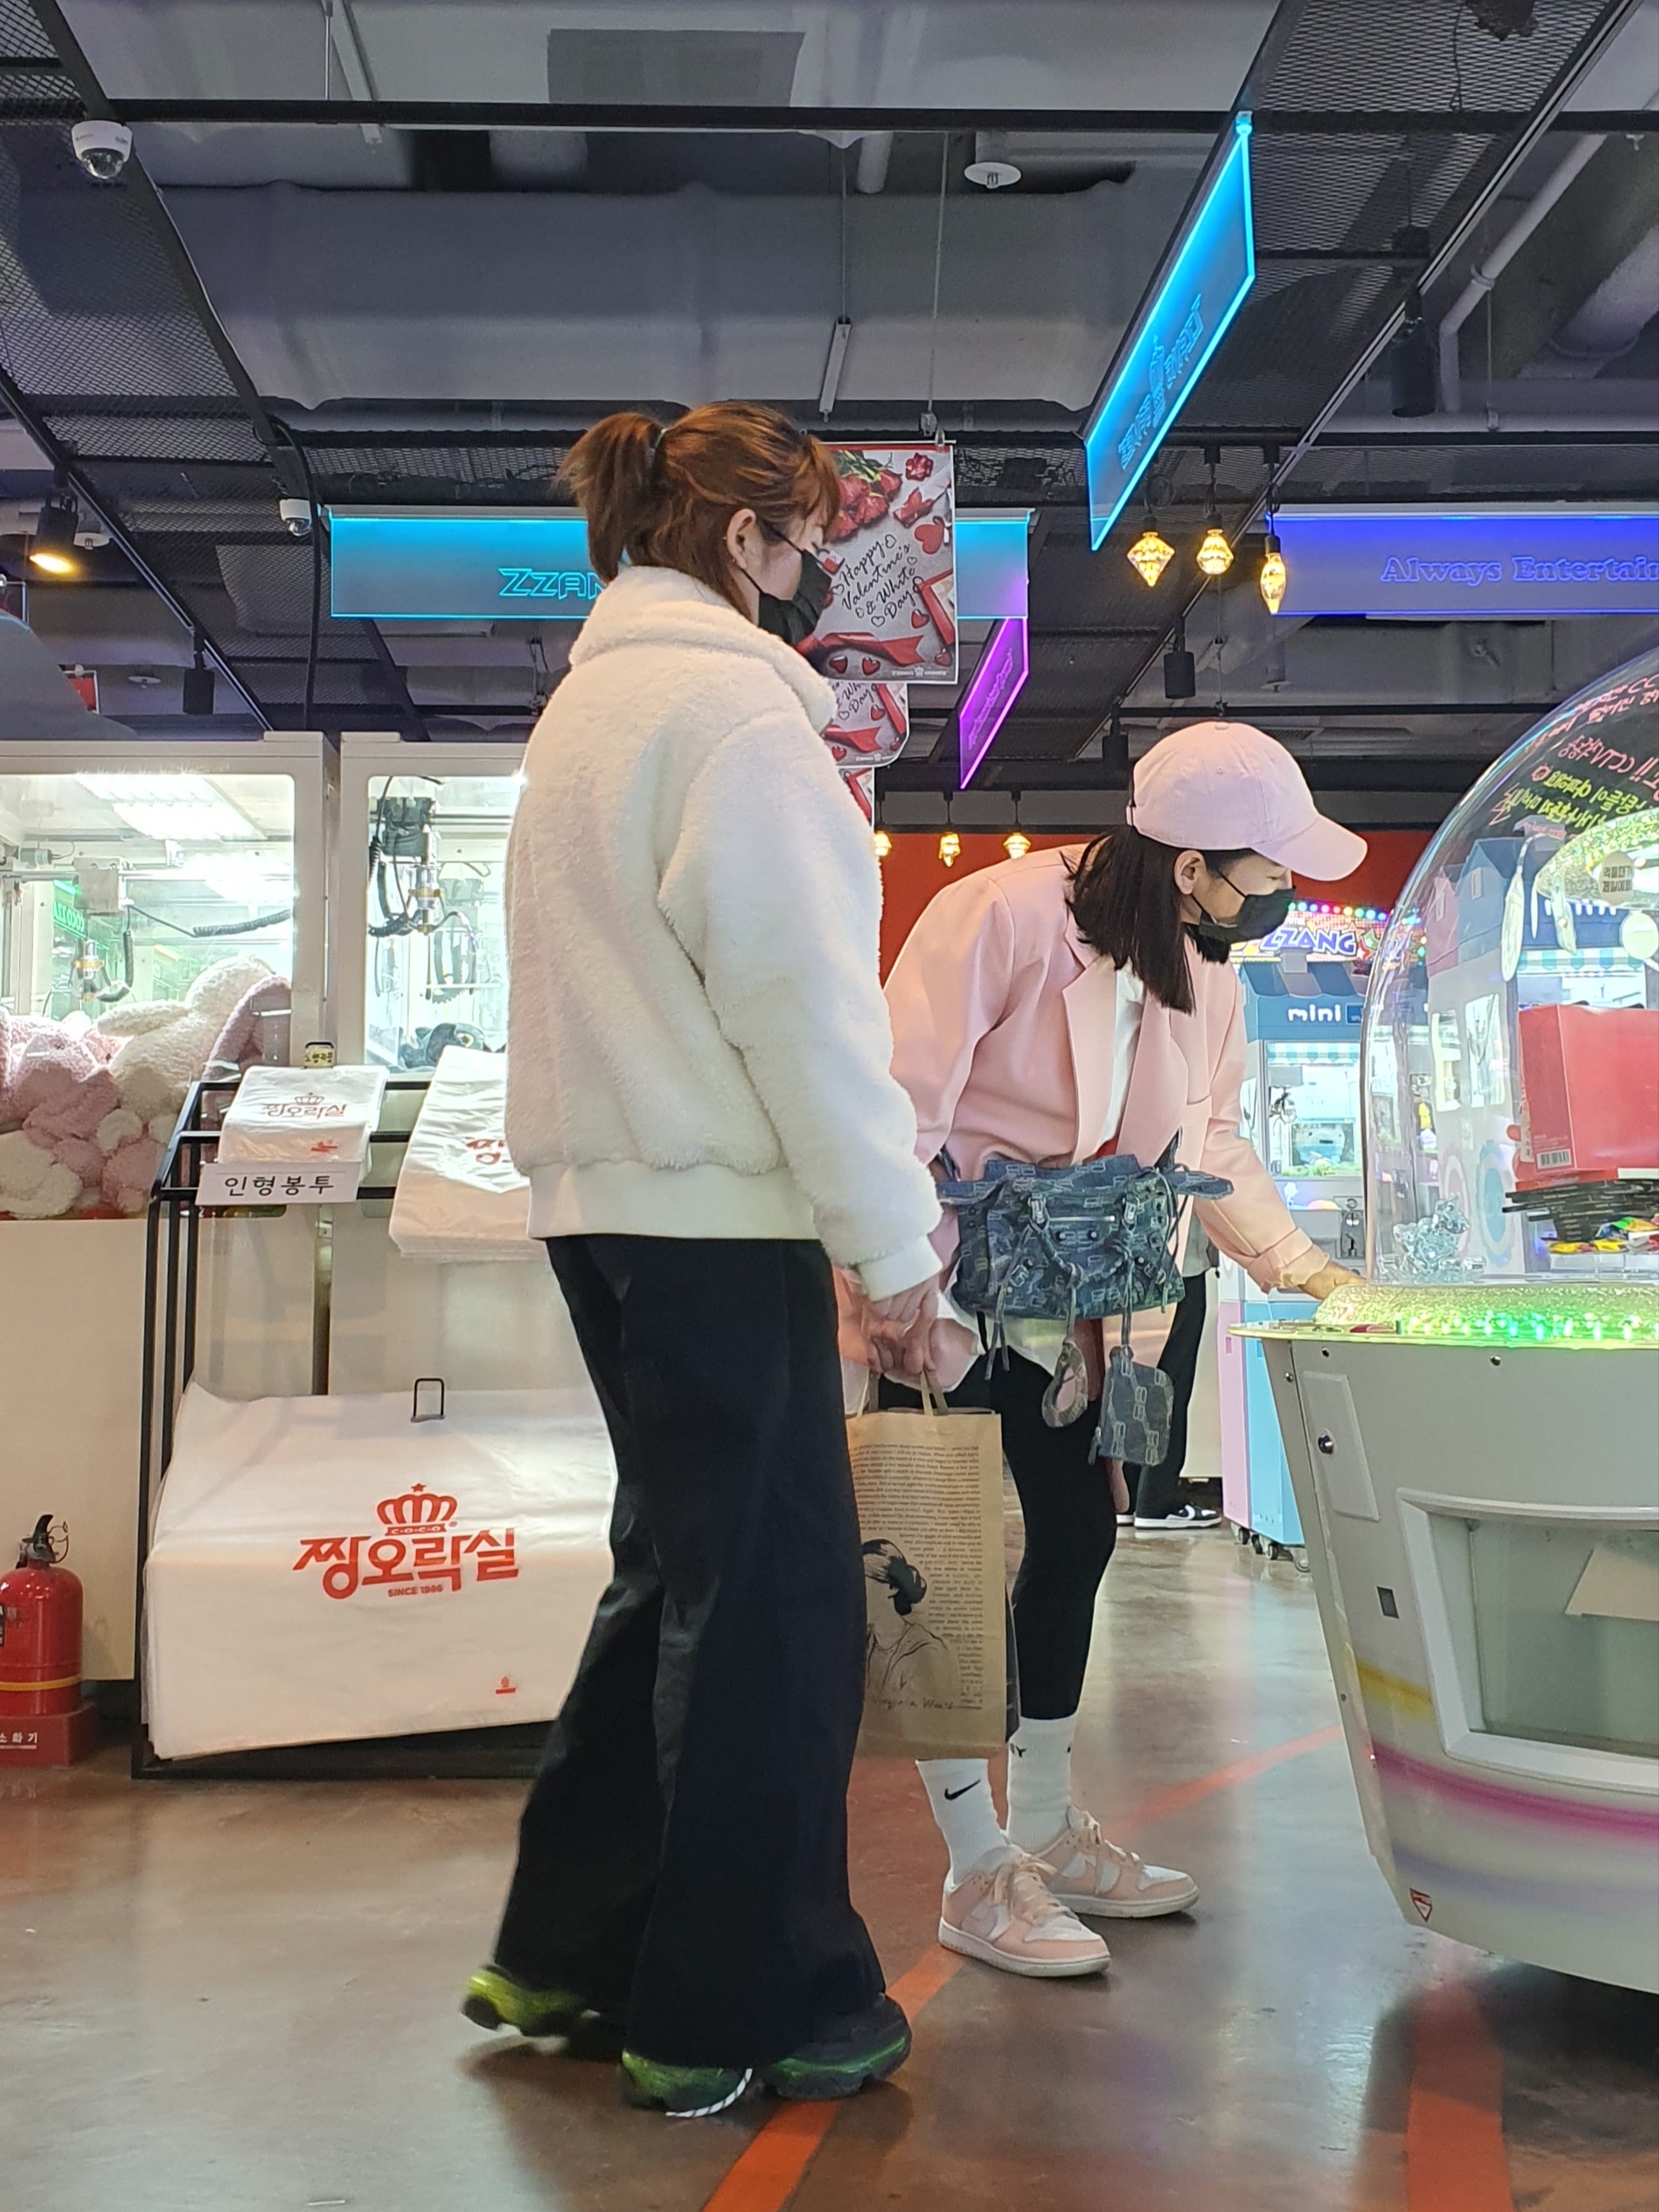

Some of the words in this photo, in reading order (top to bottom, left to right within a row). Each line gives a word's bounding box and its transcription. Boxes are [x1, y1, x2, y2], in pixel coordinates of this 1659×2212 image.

[839, 541, 885, 587] Happy
[842, 543, 910, 610] Valentine's
[1380, 556, 1502, 586] Always
[876, 566, 916, 603] White
[884, 590, 916, 620] Day
[1262, 927, 1357, 955] ZZANG
[1288, 1003, 1342, 1022] mini
[224, 1176, 334, 1196] 인형봉투
[292, 1528, 519, 1600] 짱오락실
[388, 1586, 417, 1597] SINCE
